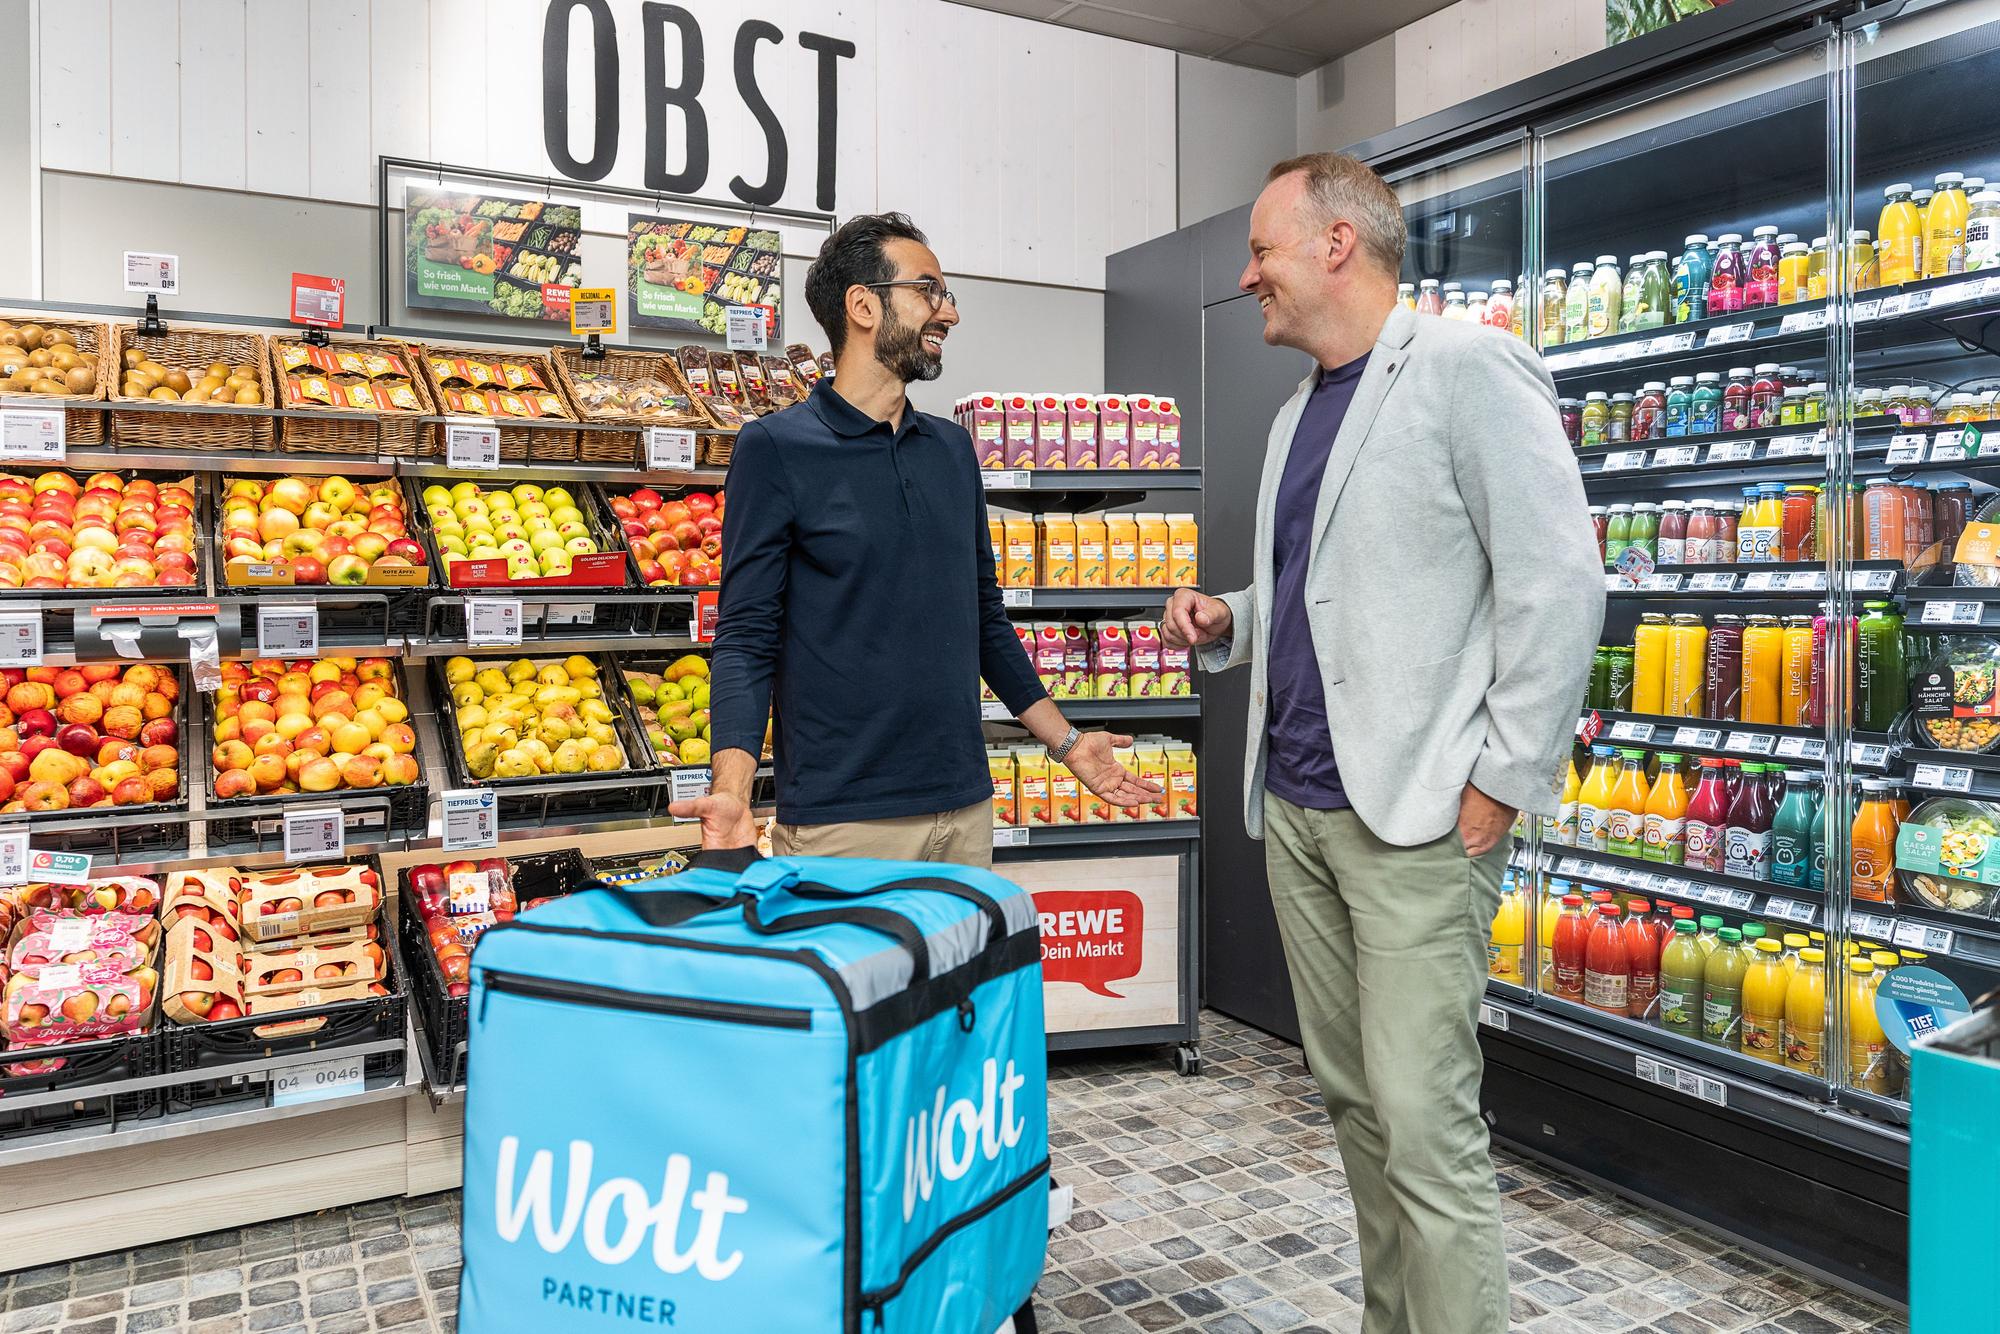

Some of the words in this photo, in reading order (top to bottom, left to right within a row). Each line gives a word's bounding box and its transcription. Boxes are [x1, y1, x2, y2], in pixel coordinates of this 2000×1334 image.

[543, 0, 856, 211] OBST
[1966, 232, 1989, 243] COCO
[423, 269, 435, 279] So
[436, 271, 461, 281] frisch
[423, 281, 439, 290] wie
[460, 284, 490, 295] Markt.
[546, 288, 570, 298] REWE
[642, 290, 653, 299] So
[654, 291, 675, 302] frisch
[642, 301, 656, 310] wie
[657, 304, 674, 312] vom
[674, 303, 699, 314] Markt.
[44, 441, 59, 451] 2.99
[1962, 604, 1978, 612] 2.99
[1811, 621, 1819, 659] fruits
[1859, 625, 1868, 660] fruits
[21, 648, 37, 658] 2.99
[1707, 633, 1718, 666] fruits
[1742, 633, 1751, 666] fruits
[1791, 635, 1801, 668] fruits
[1707, 666, 1717, 691] true
[1810, 660, 1818, 685] true
[1859, 662, 1868, 689] true
[1742, 668, 1750, 692] true
[1790, 668, 1800, 697] true
[1917, 691, 1951, 699] HÄHNCHEN
[676, 773, 704, 781] TIEFPREIS
[447, 797, 479, 808] TIEFPREIS
[480, 830, 493, 840] 1.49
[325, 840, 339, 850] 3.49
[1903, 840, 1937, 851] CAESAR
[1905, 847, 1932, 858] SALAT
[1038, 908, 1124, 938] REWE
[1932, 930, 1948, 940] 2.99
[1040, 942, 1072, 960] Dein
[1075, 939, 1124, 958] Markt
[1908, 976, 1935, 988] Produkte
[1907, 1013, 1934, 1031] TIEF
[37, 1027, 74, 1038] Pink
[75, 1024, 109, 1035] Lady
[278, 1076, 300, 1090] 04
[315, 1066, 359, 1085] 0046
[903, 1057, 1026, 1224] Wolt
[494, 1135, 749, 1281] Wolt
[542, 1277, 676, 1326] PARTNER
